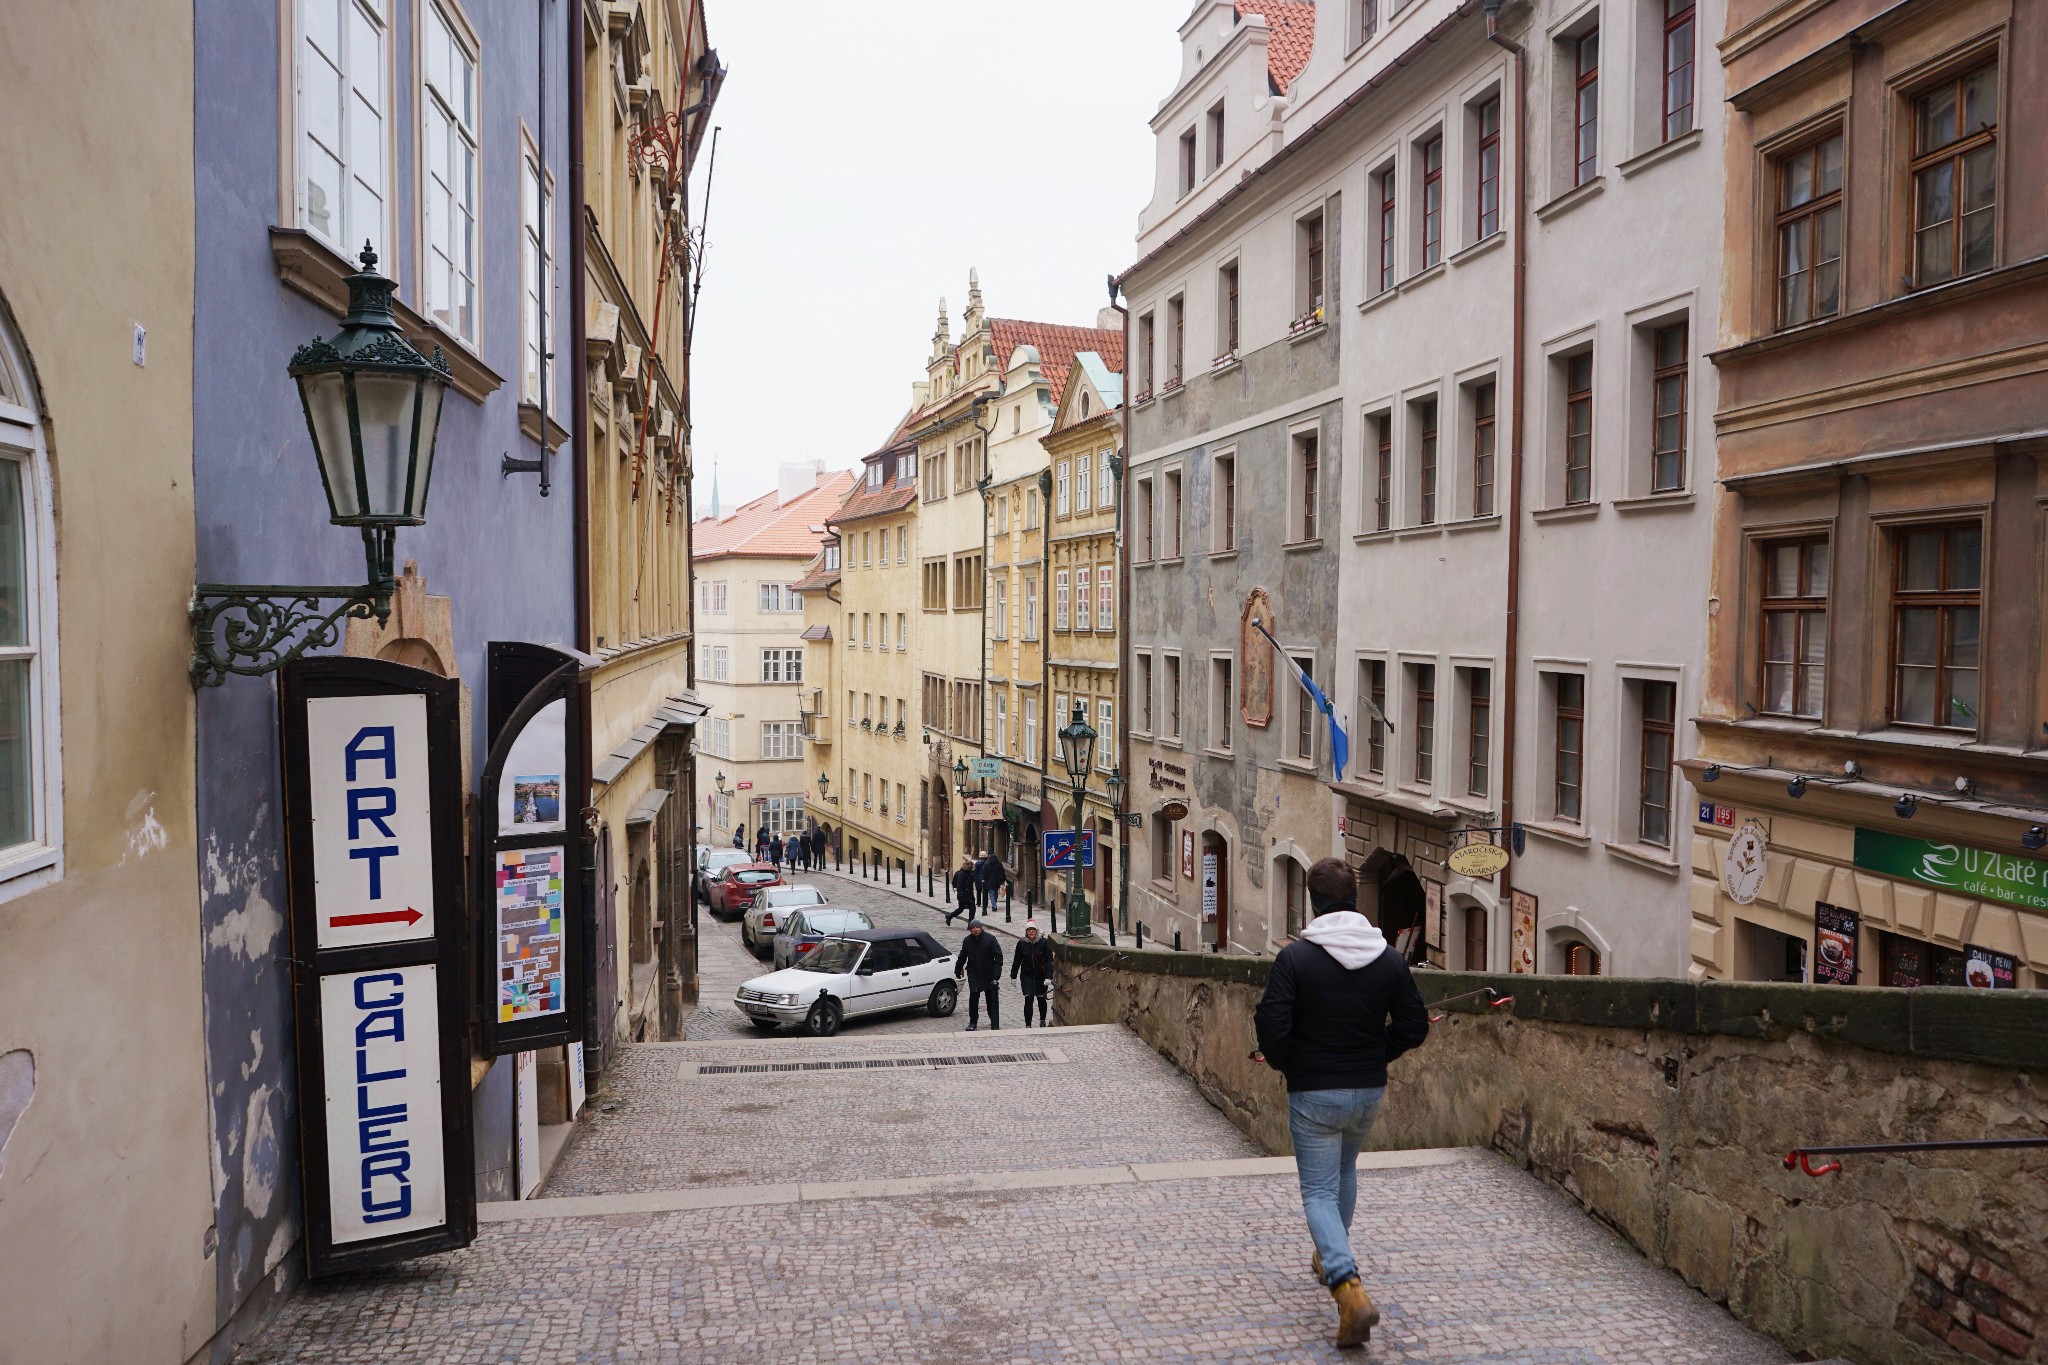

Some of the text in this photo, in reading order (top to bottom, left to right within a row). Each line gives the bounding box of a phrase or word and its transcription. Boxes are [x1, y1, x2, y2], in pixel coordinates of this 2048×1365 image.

[345, 726, 399, 900] ART
[1701, 807, 1730, 820] 21 195
[1964, 848, 1978, 872] U
[1984, 851, 2036, 885] Zlaté
[1964, 881, 2048, 908] café bar res
[1972, 950, 1992, 964] DAILY
[1995, 956, 2012, 969] MENU
[354, 972, 412, 1224] GALLERY
